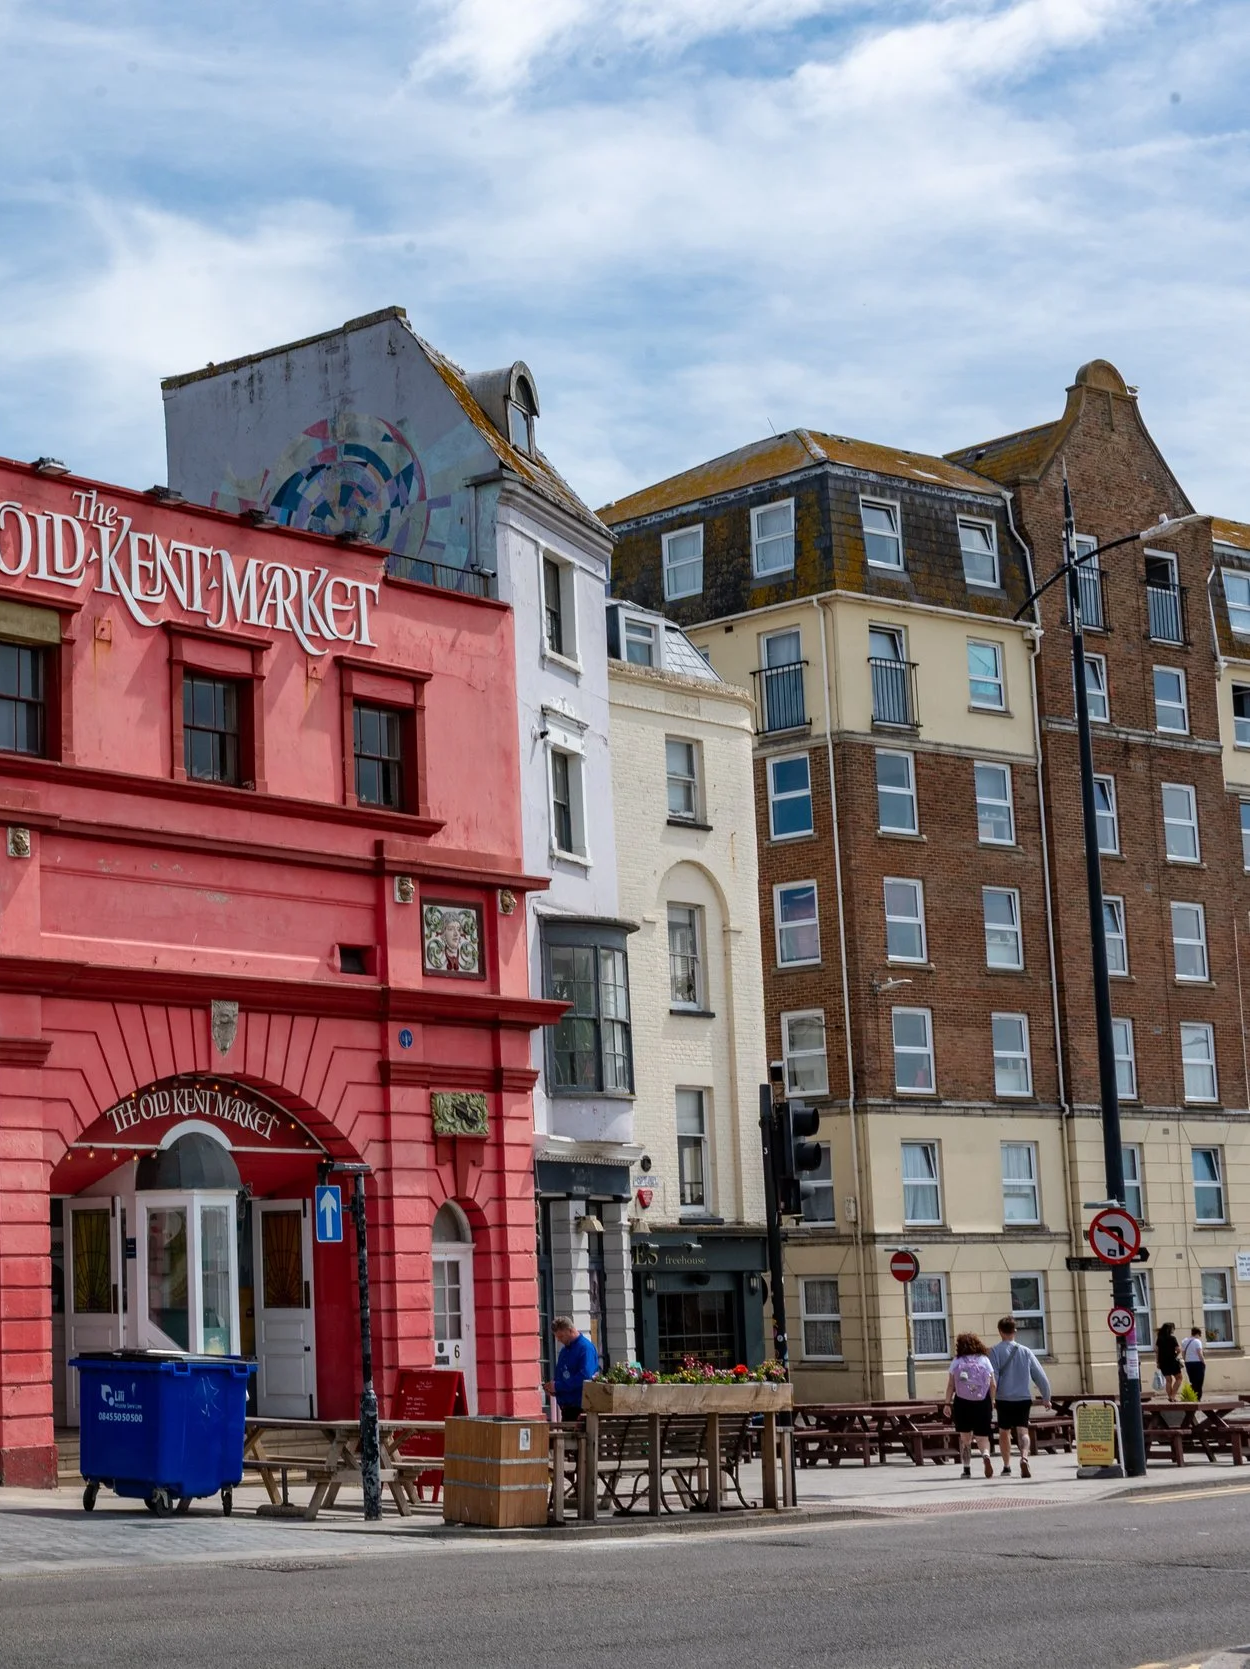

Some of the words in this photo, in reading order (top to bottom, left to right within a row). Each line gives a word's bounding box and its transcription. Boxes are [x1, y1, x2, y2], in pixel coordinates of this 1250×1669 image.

[72, 490, 119, 526] The
[92, 516, 214, 627] KENT
[206, 549, 380, 656] MARKET
[106, 1099, 141, 1135] THE
[139, 1090, 170, 1120] OLD
[172, 1087, 220, 1116] KENT
[214, 1093, 281, 1141] MARKET
[634, 1246, 659, 1265] ES
[665, 1254, 707, 1265] freehouse
[1111, 1315, 1131, 1328] 20
[454, 1344, 460, 1359] 6
